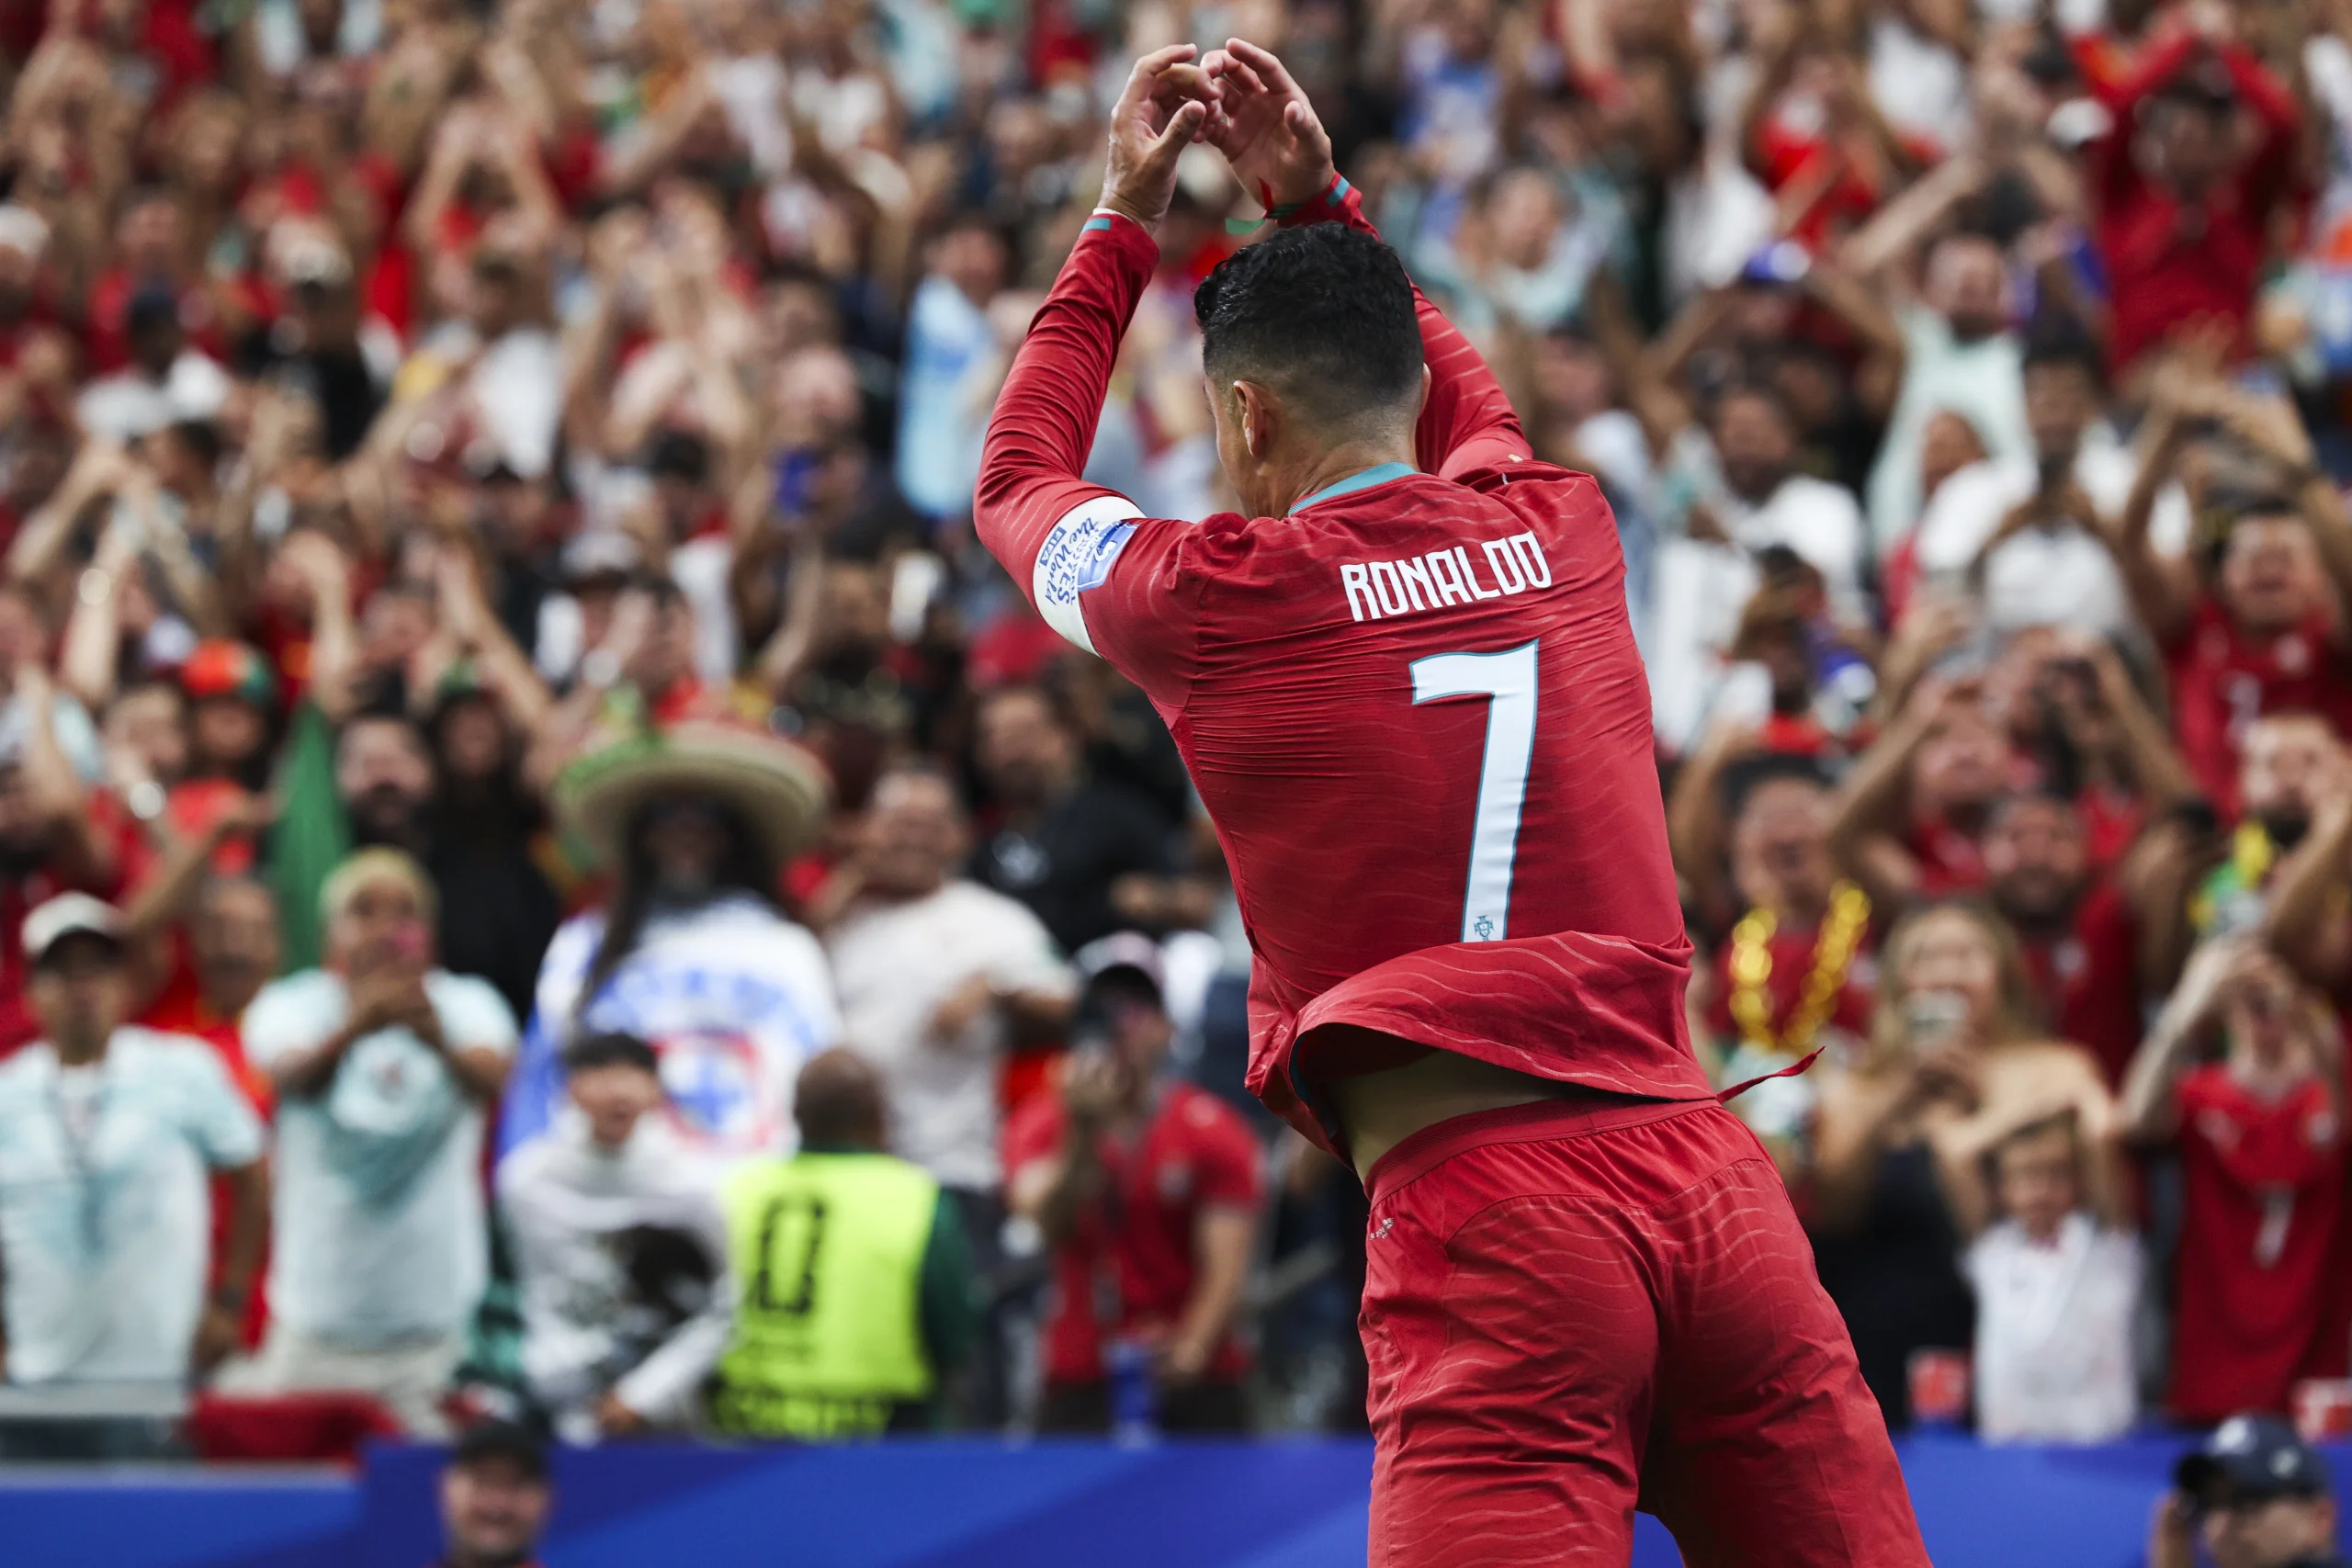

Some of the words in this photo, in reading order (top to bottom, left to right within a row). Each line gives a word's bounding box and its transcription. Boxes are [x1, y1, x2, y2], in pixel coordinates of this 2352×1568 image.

[1040, 527, 1066, 564] FIFA
[1046, 544, 1072, 605] World
[1340, 530, 1553, 622] RONALDO
[1408, 637, 1539, 942] 7
